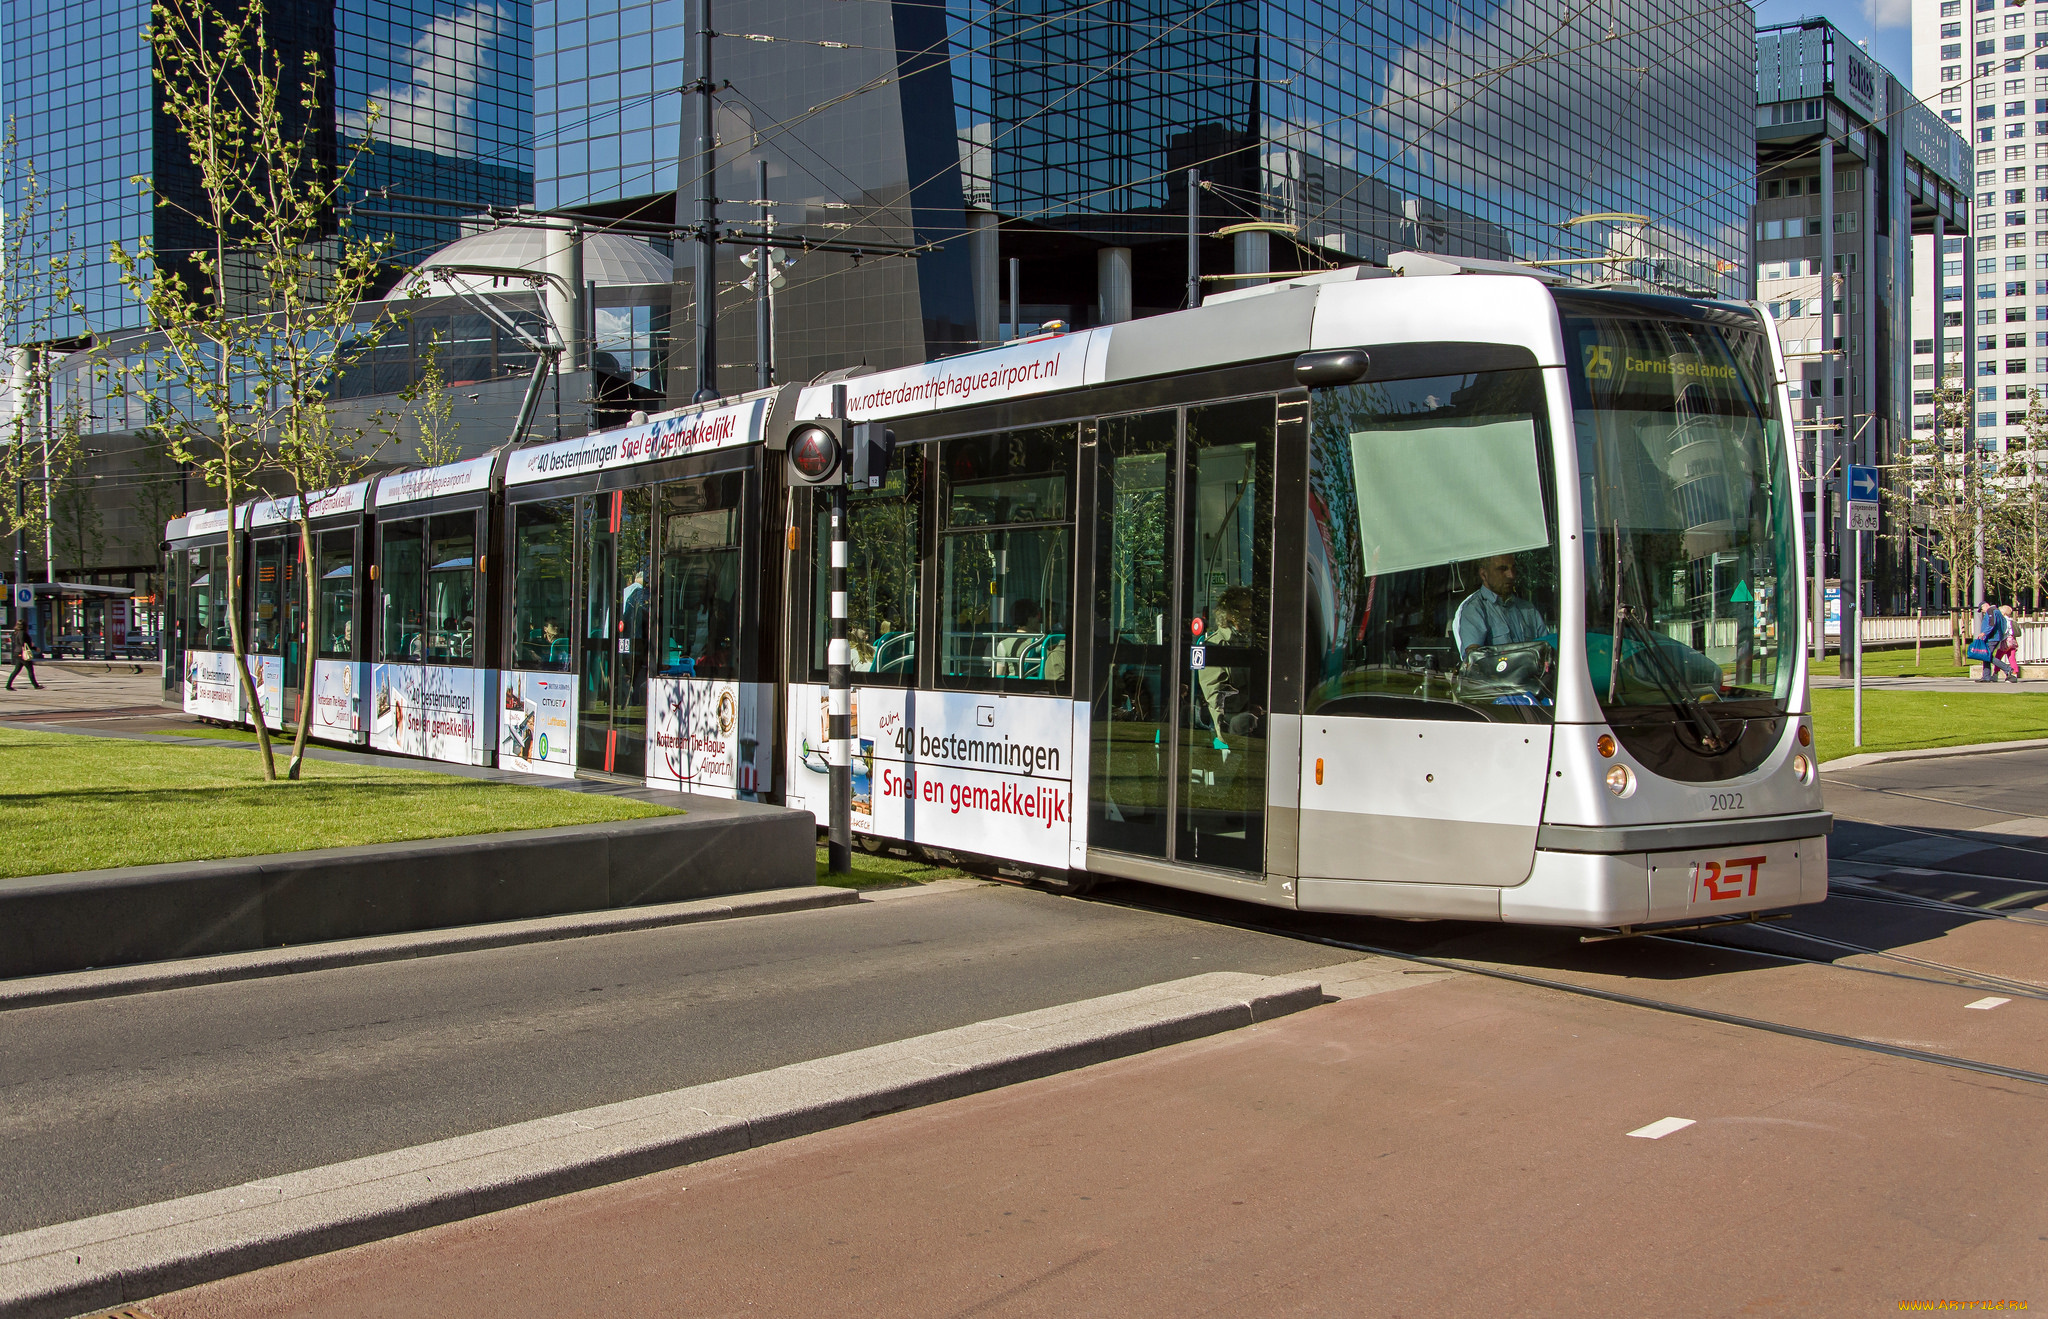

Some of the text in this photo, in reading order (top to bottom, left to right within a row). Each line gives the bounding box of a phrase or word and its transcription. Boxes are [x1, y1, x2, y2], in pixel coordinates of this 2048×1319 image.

[1584, 345, 1737, 380] 25 Carnisselande
[537, 415, 736, 473] 40 bestemmingen Snel en gemakkelijk!
[412, 688, 470, 713] 40 bestemmingen
[431, 717, 475, 743] gemakkelijk!
[656, 732, 726, 758] Rotterdam The Hague
[894, 727, 1060, 775] 40 bestemmingen
[700, 757, 734, 778] Airport.nl
[883, 769, 1073, 828] Snel en gemakkelijk!
[1710, 793, 1744, 811] 2022
[1693, 856, 1766, 902] RET
